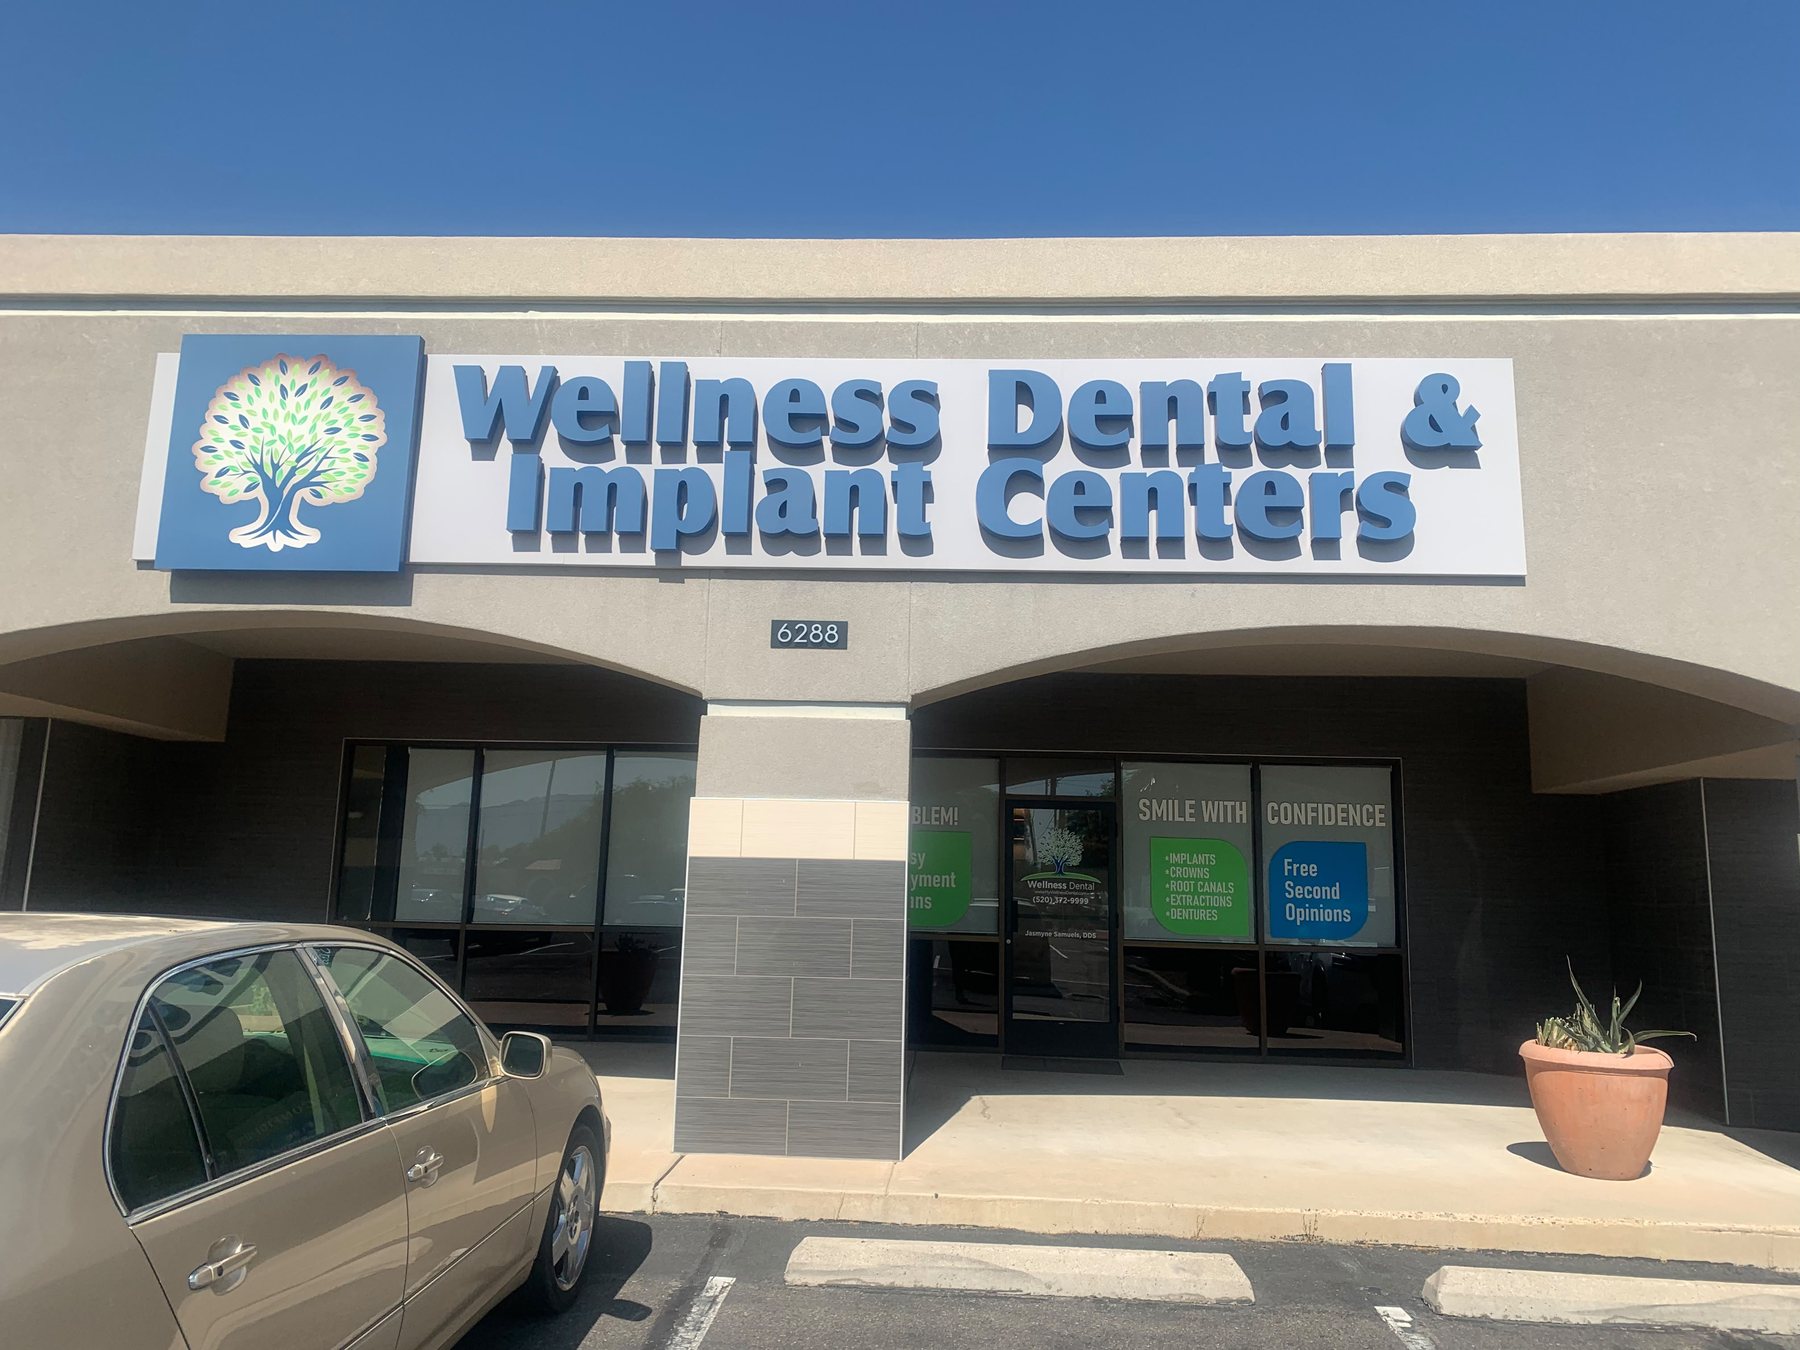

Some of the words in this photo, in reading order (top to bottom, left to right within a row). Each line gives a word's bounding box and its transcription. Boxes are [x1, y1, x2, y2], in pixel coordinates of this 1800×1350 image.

[453, 361, 940, 449] Wellness
[987, 362, 1355, 452] Dental
[1401, 372, 1484, 452] &
[506, 450, 934, 551] Implant
[975, 457, 1417, 544] Centers
[777, 623, 839, 644] 6288
[1138, 798, 1196, 822] SMILE
[1201, 800, 1248, 823] WITH
[1266, 801, 1387, 827] CONFIDENCE
[1169, 853, 1216, 866] IMPLANTS
[1170, 866, 1210, 879] CROWNS
[1283, 858, 1318, 877] Free
[1027, 880, 1067, 890] Wellness
[1069, 881, 1095, 891] Dental
[1170, 880, 1195, 892] ROOT
[1197, 881, 1235, 894] CANALS
[1285, 880, 1340, 900] Second
[1032, 896, 1053, 904] (520)
[1054, 896, 1089, 905] 372-9999
[1170, 894, 1233, 908] EXTRACTIONS
[1170, 908, 1218, 921] DENTURES
[1285, 903, 1352, 926] Opinions
[1025, 930, 1052, 938] Jasmyne
[1053, 931, 1082, 939] Samuels,
[1083, 931, 1097, 939] DDS
